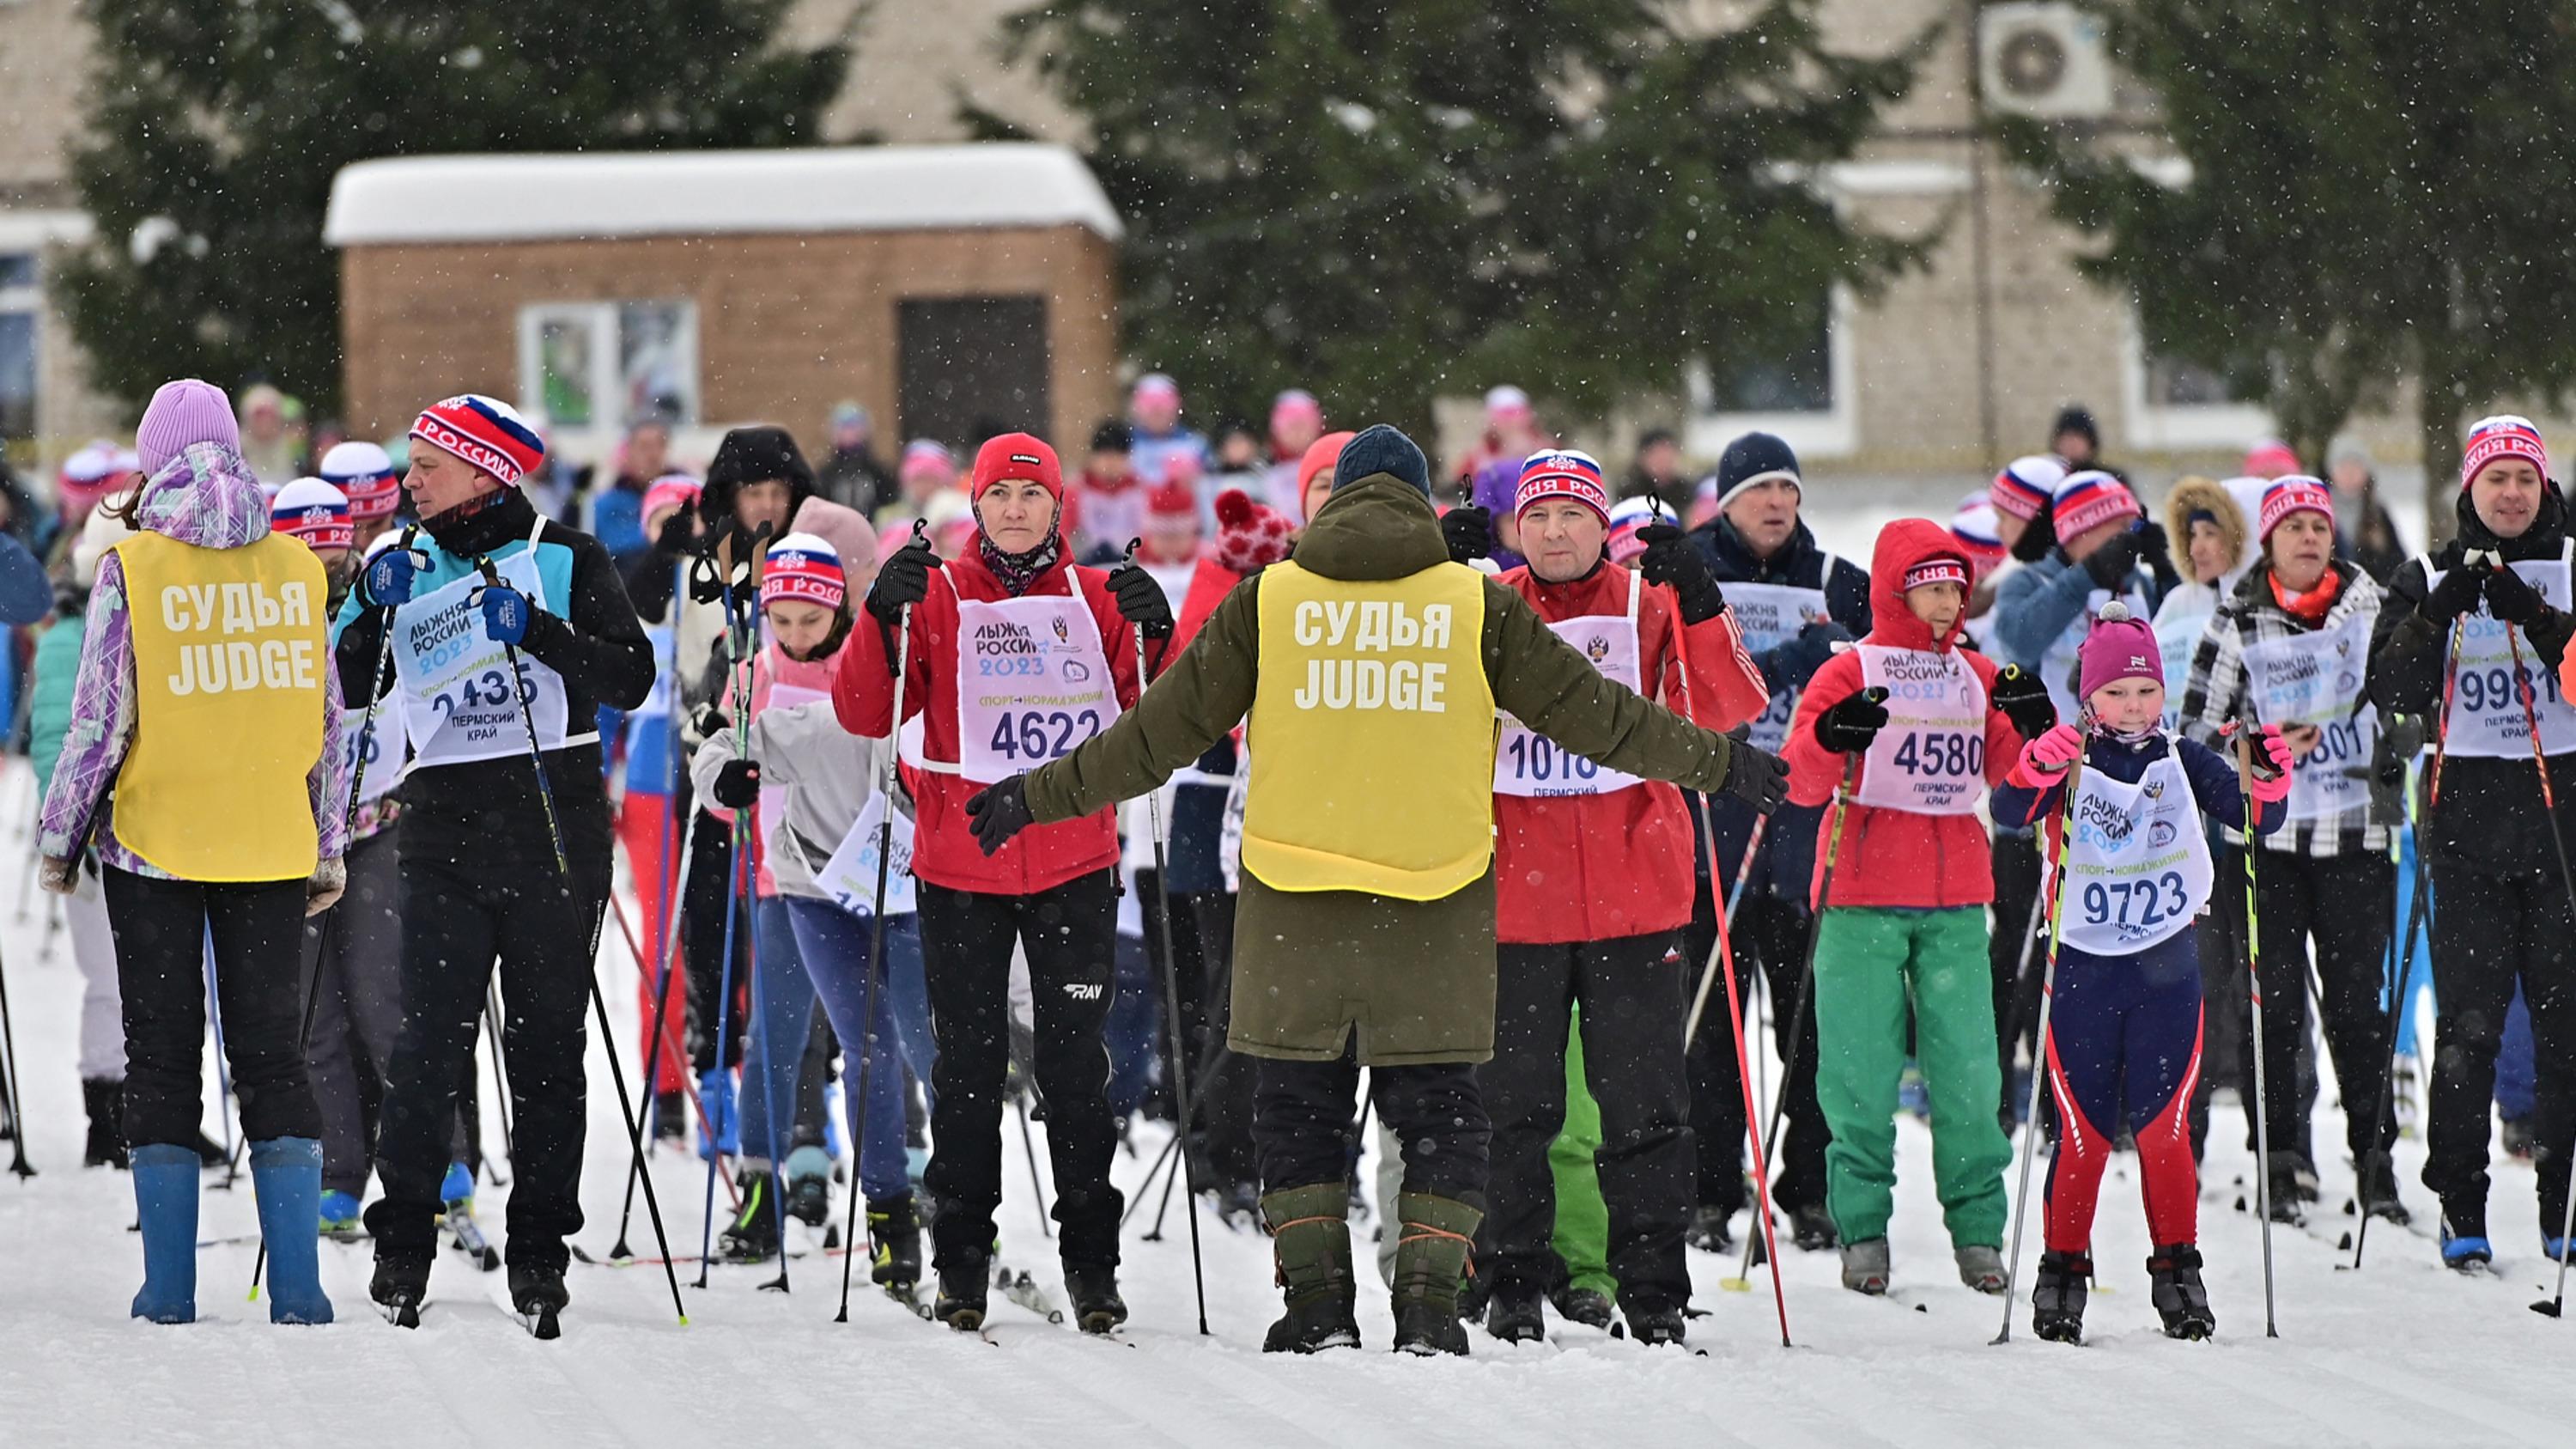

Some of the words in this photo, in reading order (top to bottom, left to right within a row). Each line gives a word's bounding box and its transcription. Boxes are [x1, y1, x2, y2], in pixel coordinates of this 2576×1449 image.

[424, 422, 513, 480] РОССИИ
[161, 581, 310, 634] СУДЬЯ
[409, 600, 467, 643] ЛЫЖНЯ
[1295, 600, 1452, 652] СУДЬЯ
[414, 615, 471, 657] РОССИИ
[419, 635, 473, 677] 2023
[168, 640, 316, 696] JUDGE
[979, 657, 1045, 677] 2023
[1295, 660, 1448, 713] JUDGE
[1884, 667, 1946, 681] РОССИИ
[979, 696, 1015, 708] СПОРТ
[2460, 667, 2555, 713] 9981
[452, 711, 515, 728] ПЕРМСКИЙ
[467, 727, 497, 741] КРАЙ
[991, 709, 1101, 760] 4622
[2485, 711, 2545, 728] ПЕРМСКЙ
[1893, 732, 1984, 776] 4580
[1913, 782, 1967, 795] ПЕРМСКИЙ
[2083, 870, 2188, 926] 9723
